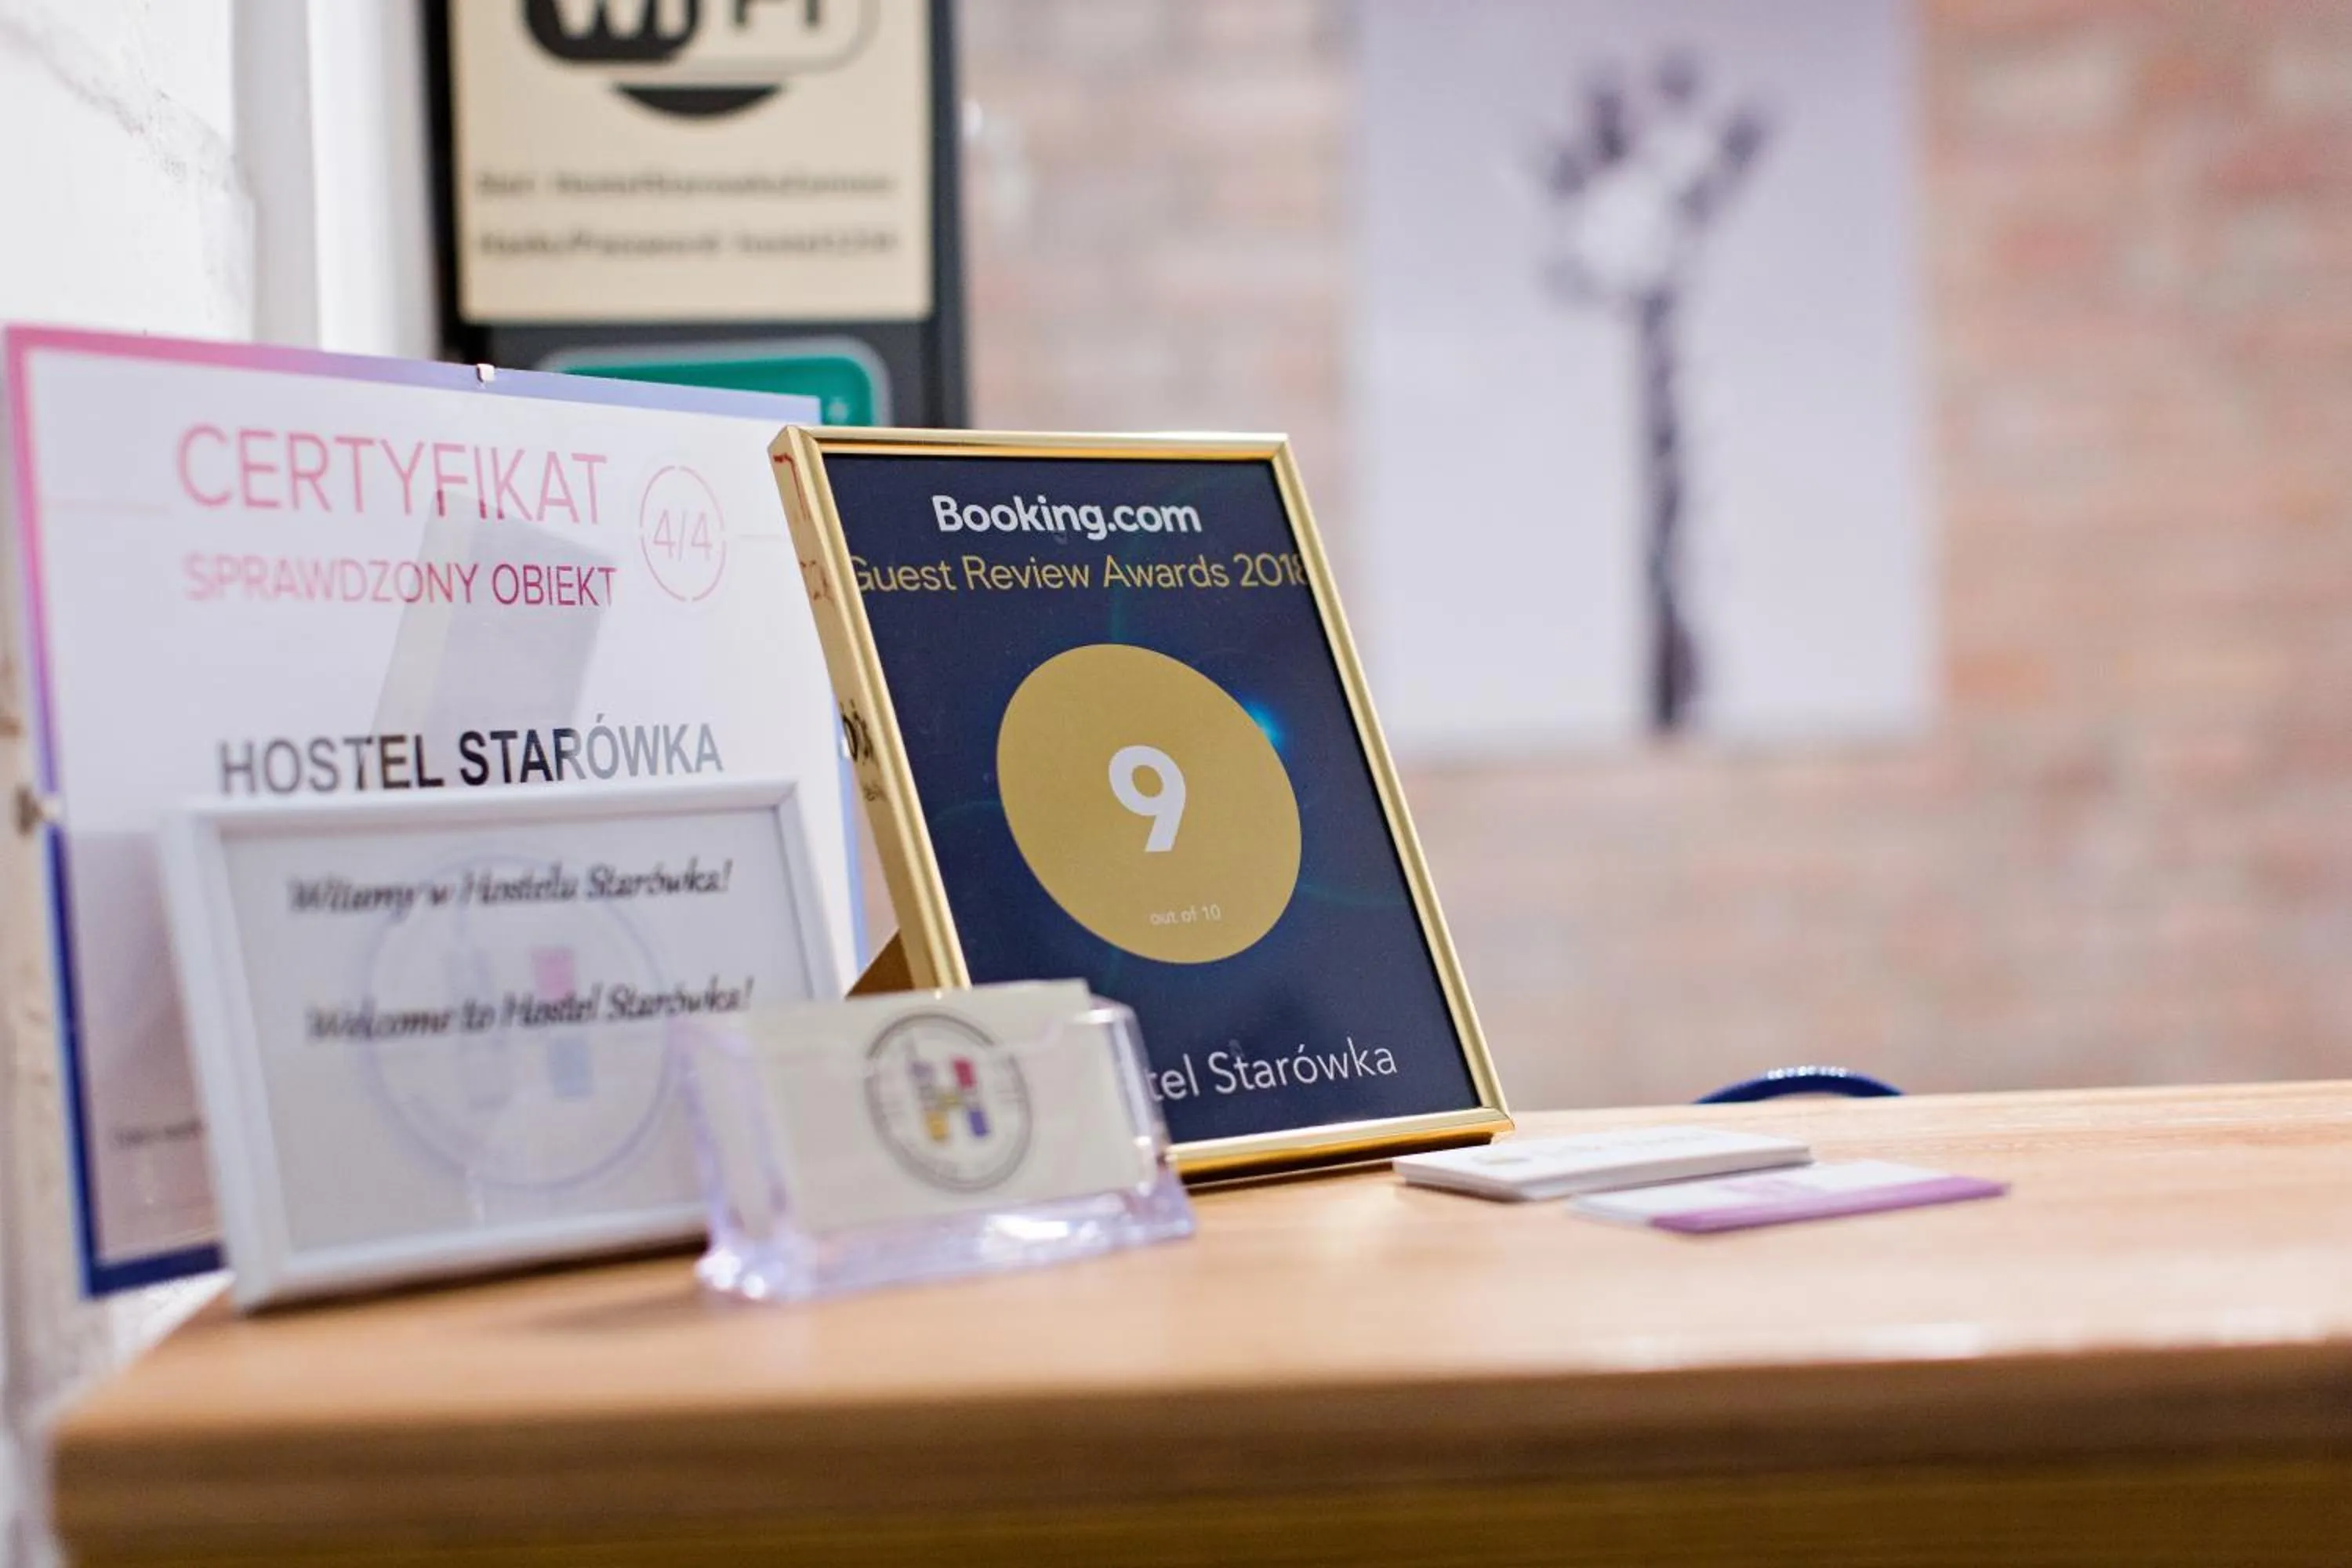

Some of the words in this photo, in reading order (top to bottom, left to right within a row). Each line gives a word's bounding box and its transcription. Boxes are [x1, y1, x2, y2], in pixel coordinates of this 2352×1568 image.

[177, 423, 607, 525] CERTYFIKAT
[652, 509, 713, 562] 4/4
[932, 495, 1203, 540] Booking.com
[182, 552, 480, 605] SPRAWDZONY
[492, 563, 618, 607] OBIEKT
[851, 555, 956, 591] Guest
[961, 555, 1089, 590] Review
[1103, 553, 1230, 589] Awards
[219, 735, 444, 797] HOSTEL
[459, 714, 724, 786] STARÓWKA
[1108, 744, 1187, 853] 9
[289, 876, 417, 926] Witamy
[586, 855, 735, 900] Starówka!
[1149, 909, 1178, 925] out
[1181, 904, 1197, 924] of
[1201, 903, 1221, 920] 10
[307, 996, 452, 1041] Welcome
[461, 997, 497, 1036] to
[500, 980, 604, 1029] Hostel
[605, 974, 755, 1024] Starówka!
[1208, 1036, 1398, 1094] Starówka
